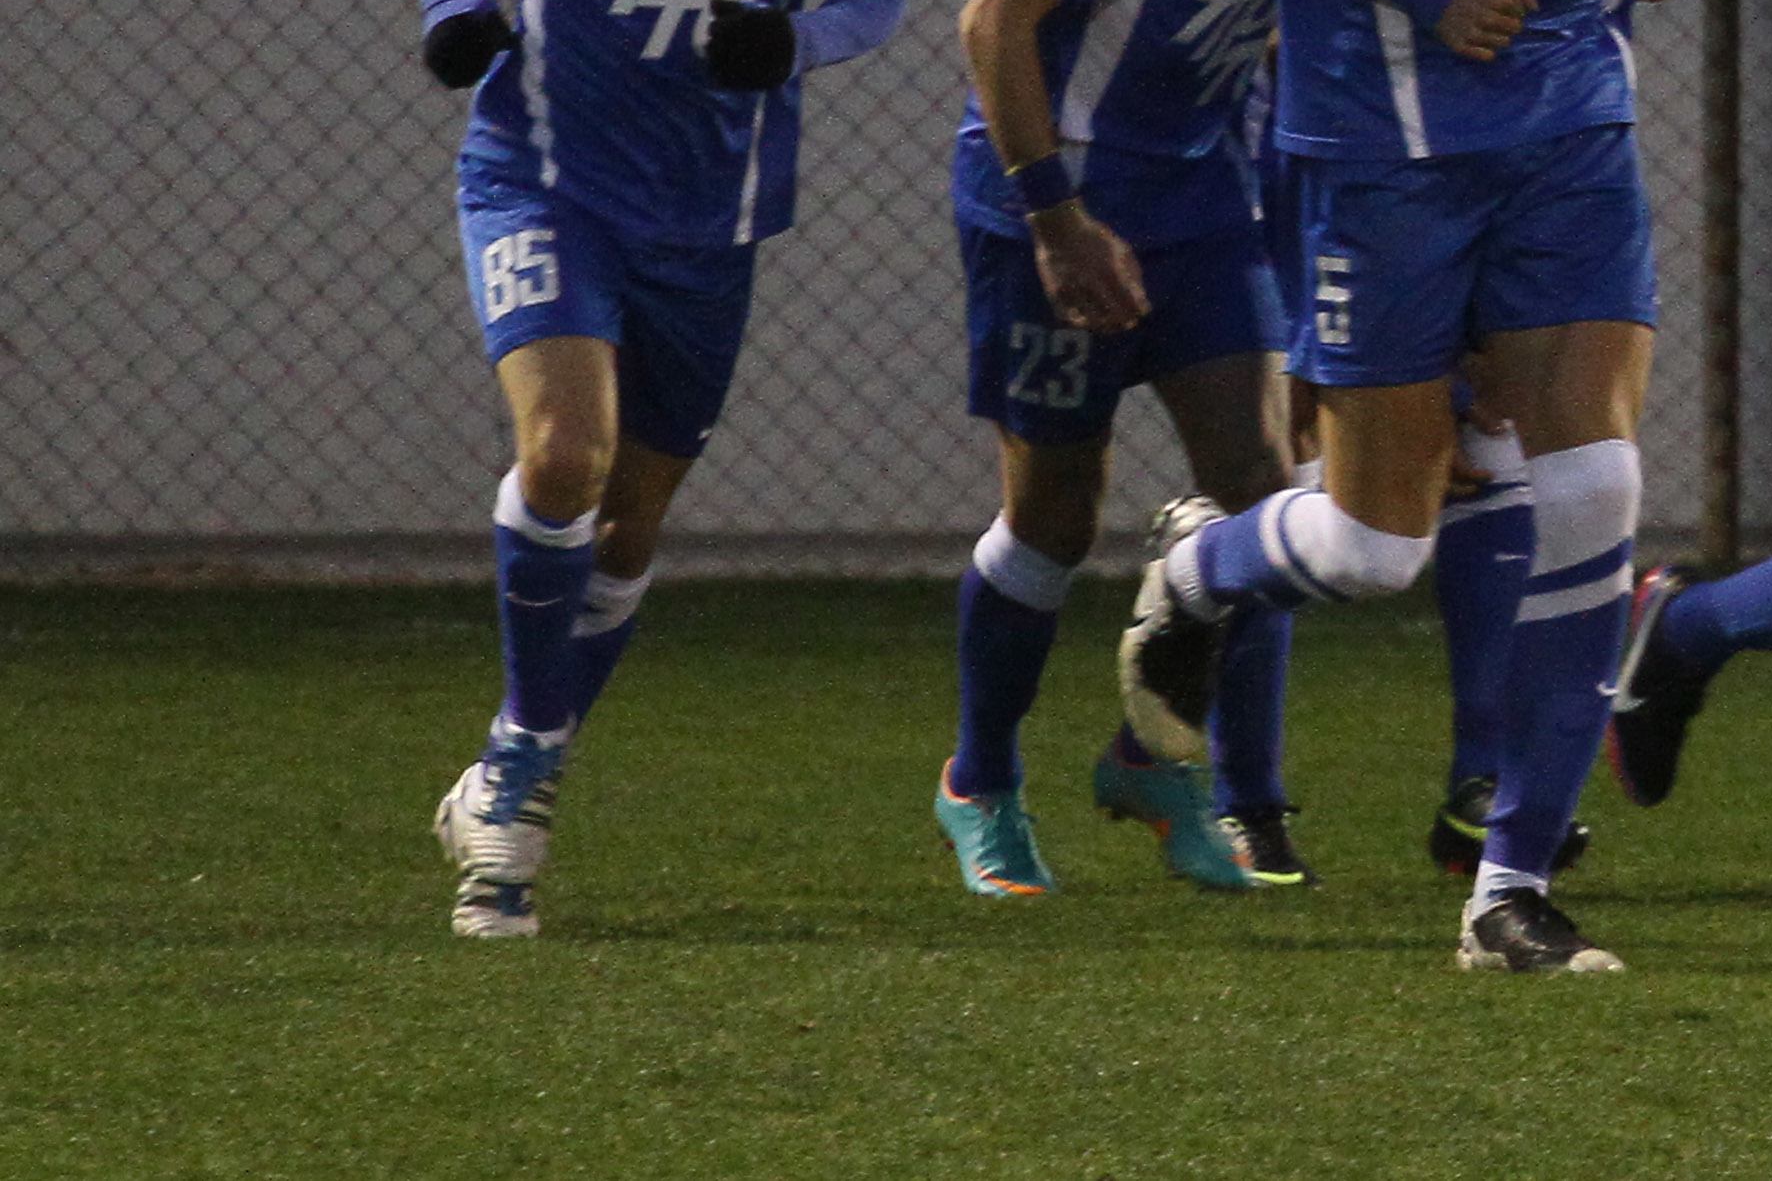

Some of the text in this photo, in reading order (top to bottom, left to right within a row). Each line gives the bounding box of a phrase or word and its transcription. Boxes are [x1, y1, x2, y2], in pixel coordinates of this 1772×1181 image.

[482, 230, 560, 321] 85
[1315, 256, 1351, 344] 5
[1007, 322, 1089, 409] 23
